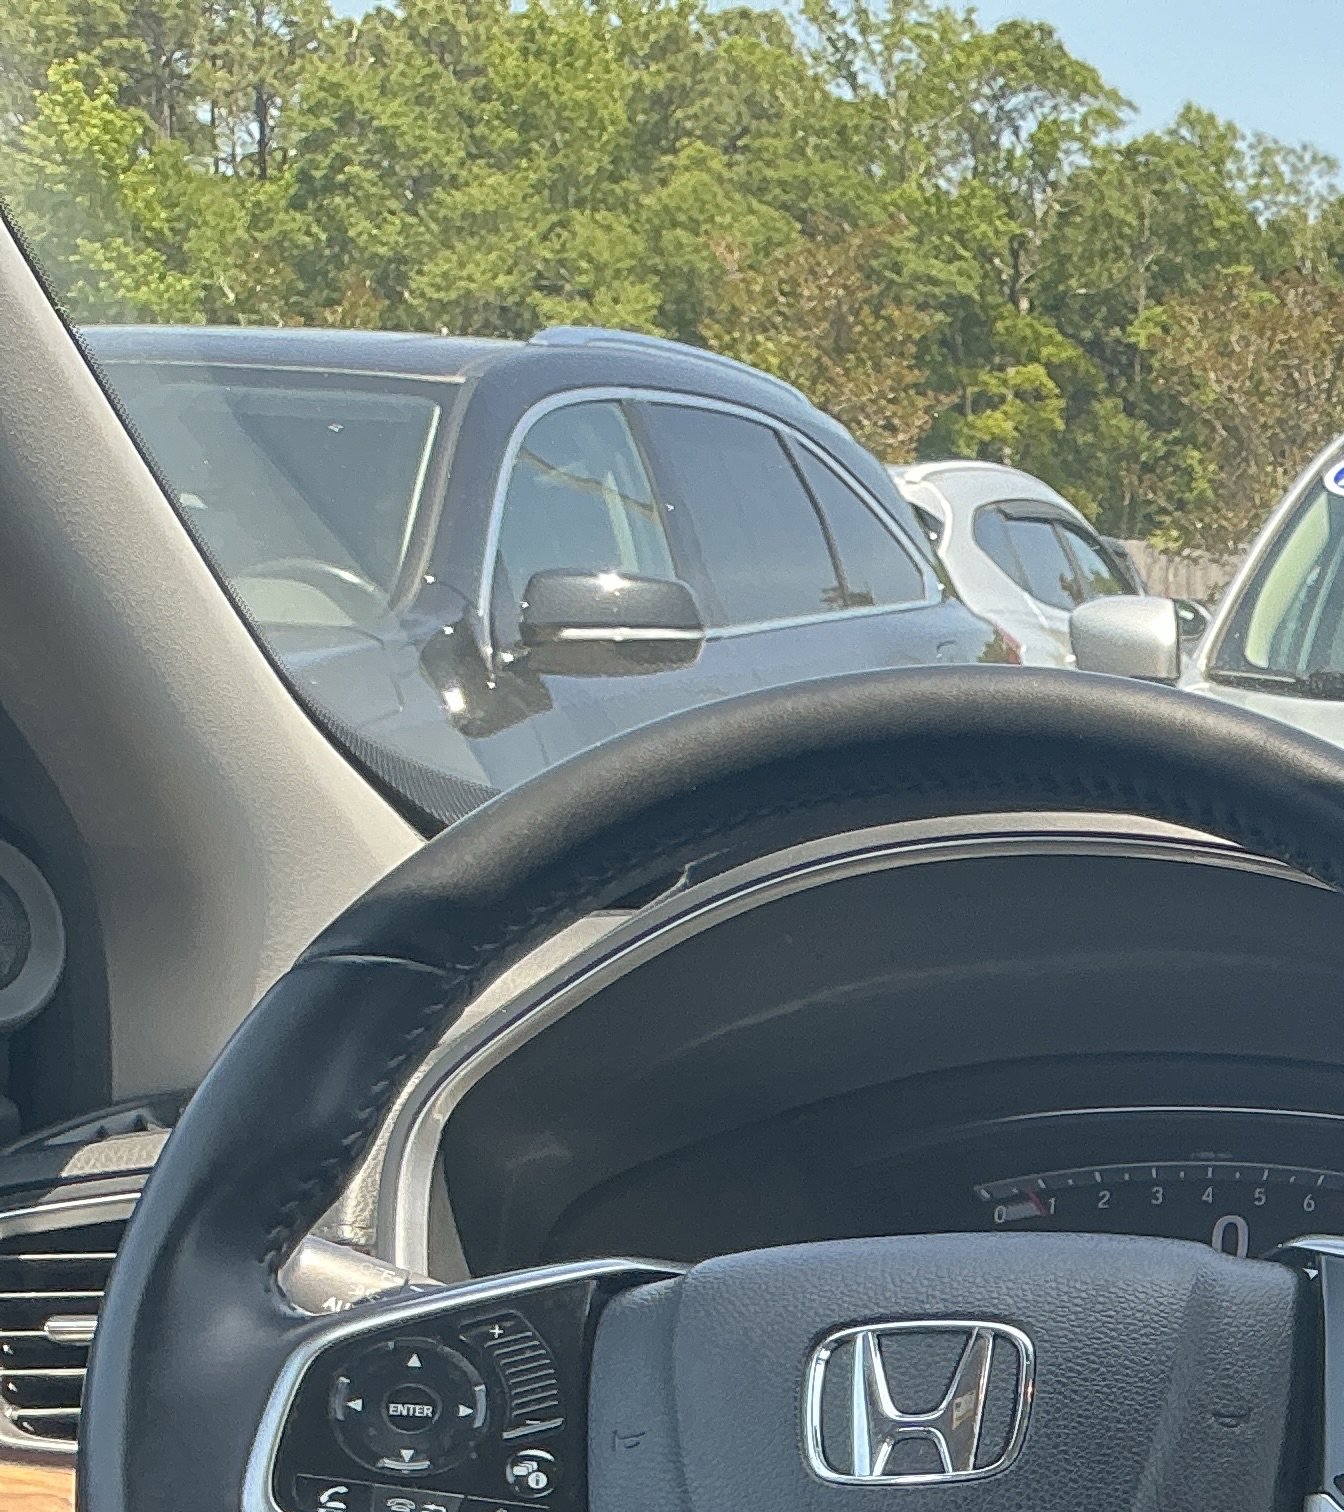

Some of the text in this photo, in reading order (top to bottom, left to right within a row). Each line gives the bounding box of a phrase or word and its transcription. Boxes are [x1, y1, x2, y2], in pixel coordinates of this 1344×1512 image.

[1099, 1191, 1111, 1208] 2
[1151, 1187, 1164, 1205] 3
[1201, 1186, 1214, 1204] 4
[1254, 1188, 1266, 1206] 5
[1303, 1194, 1315, 1212] 6
[389, 1403, 433, 1418] ENTER
